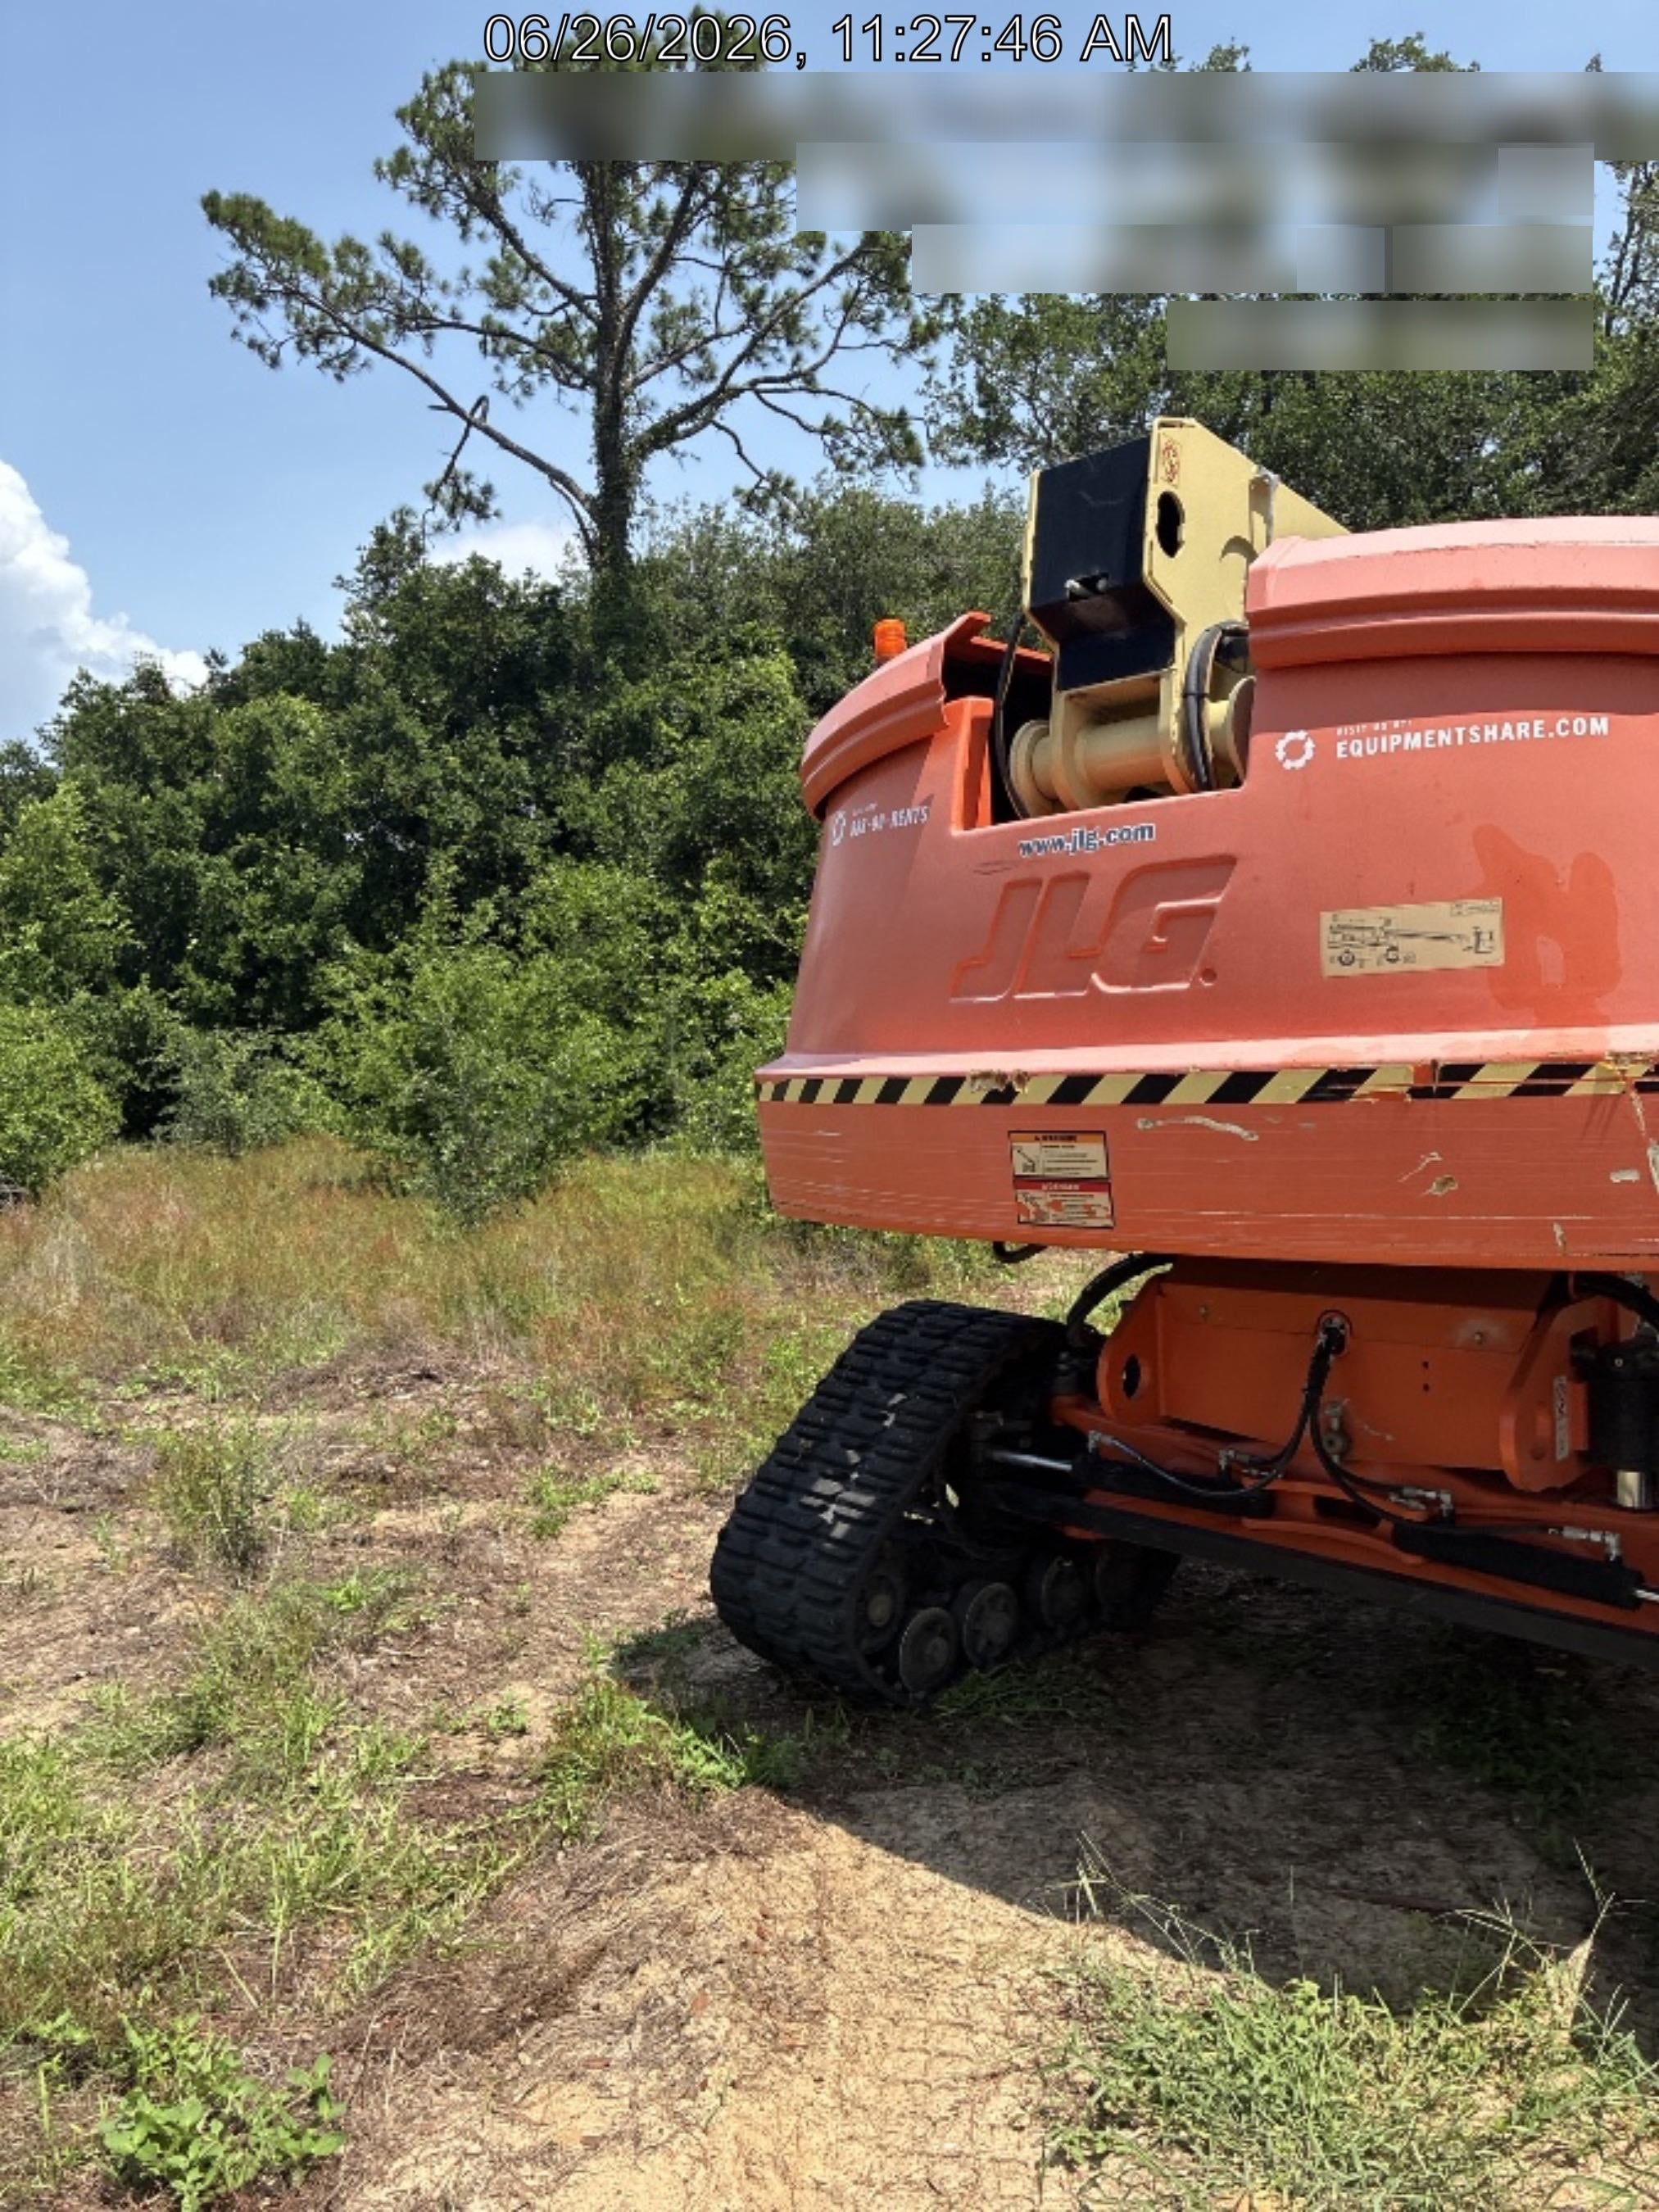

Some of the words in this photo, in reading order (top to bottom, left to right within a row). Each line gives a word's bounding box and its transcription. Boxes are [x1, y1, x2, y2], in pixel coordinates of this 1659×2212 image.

[1336, 717, 1609, 759] EQUIPMENTSHARE.COM
[1018, 823, 1156, 858] www.jlg.com
[949, 854, 1238, 1003] JLG
